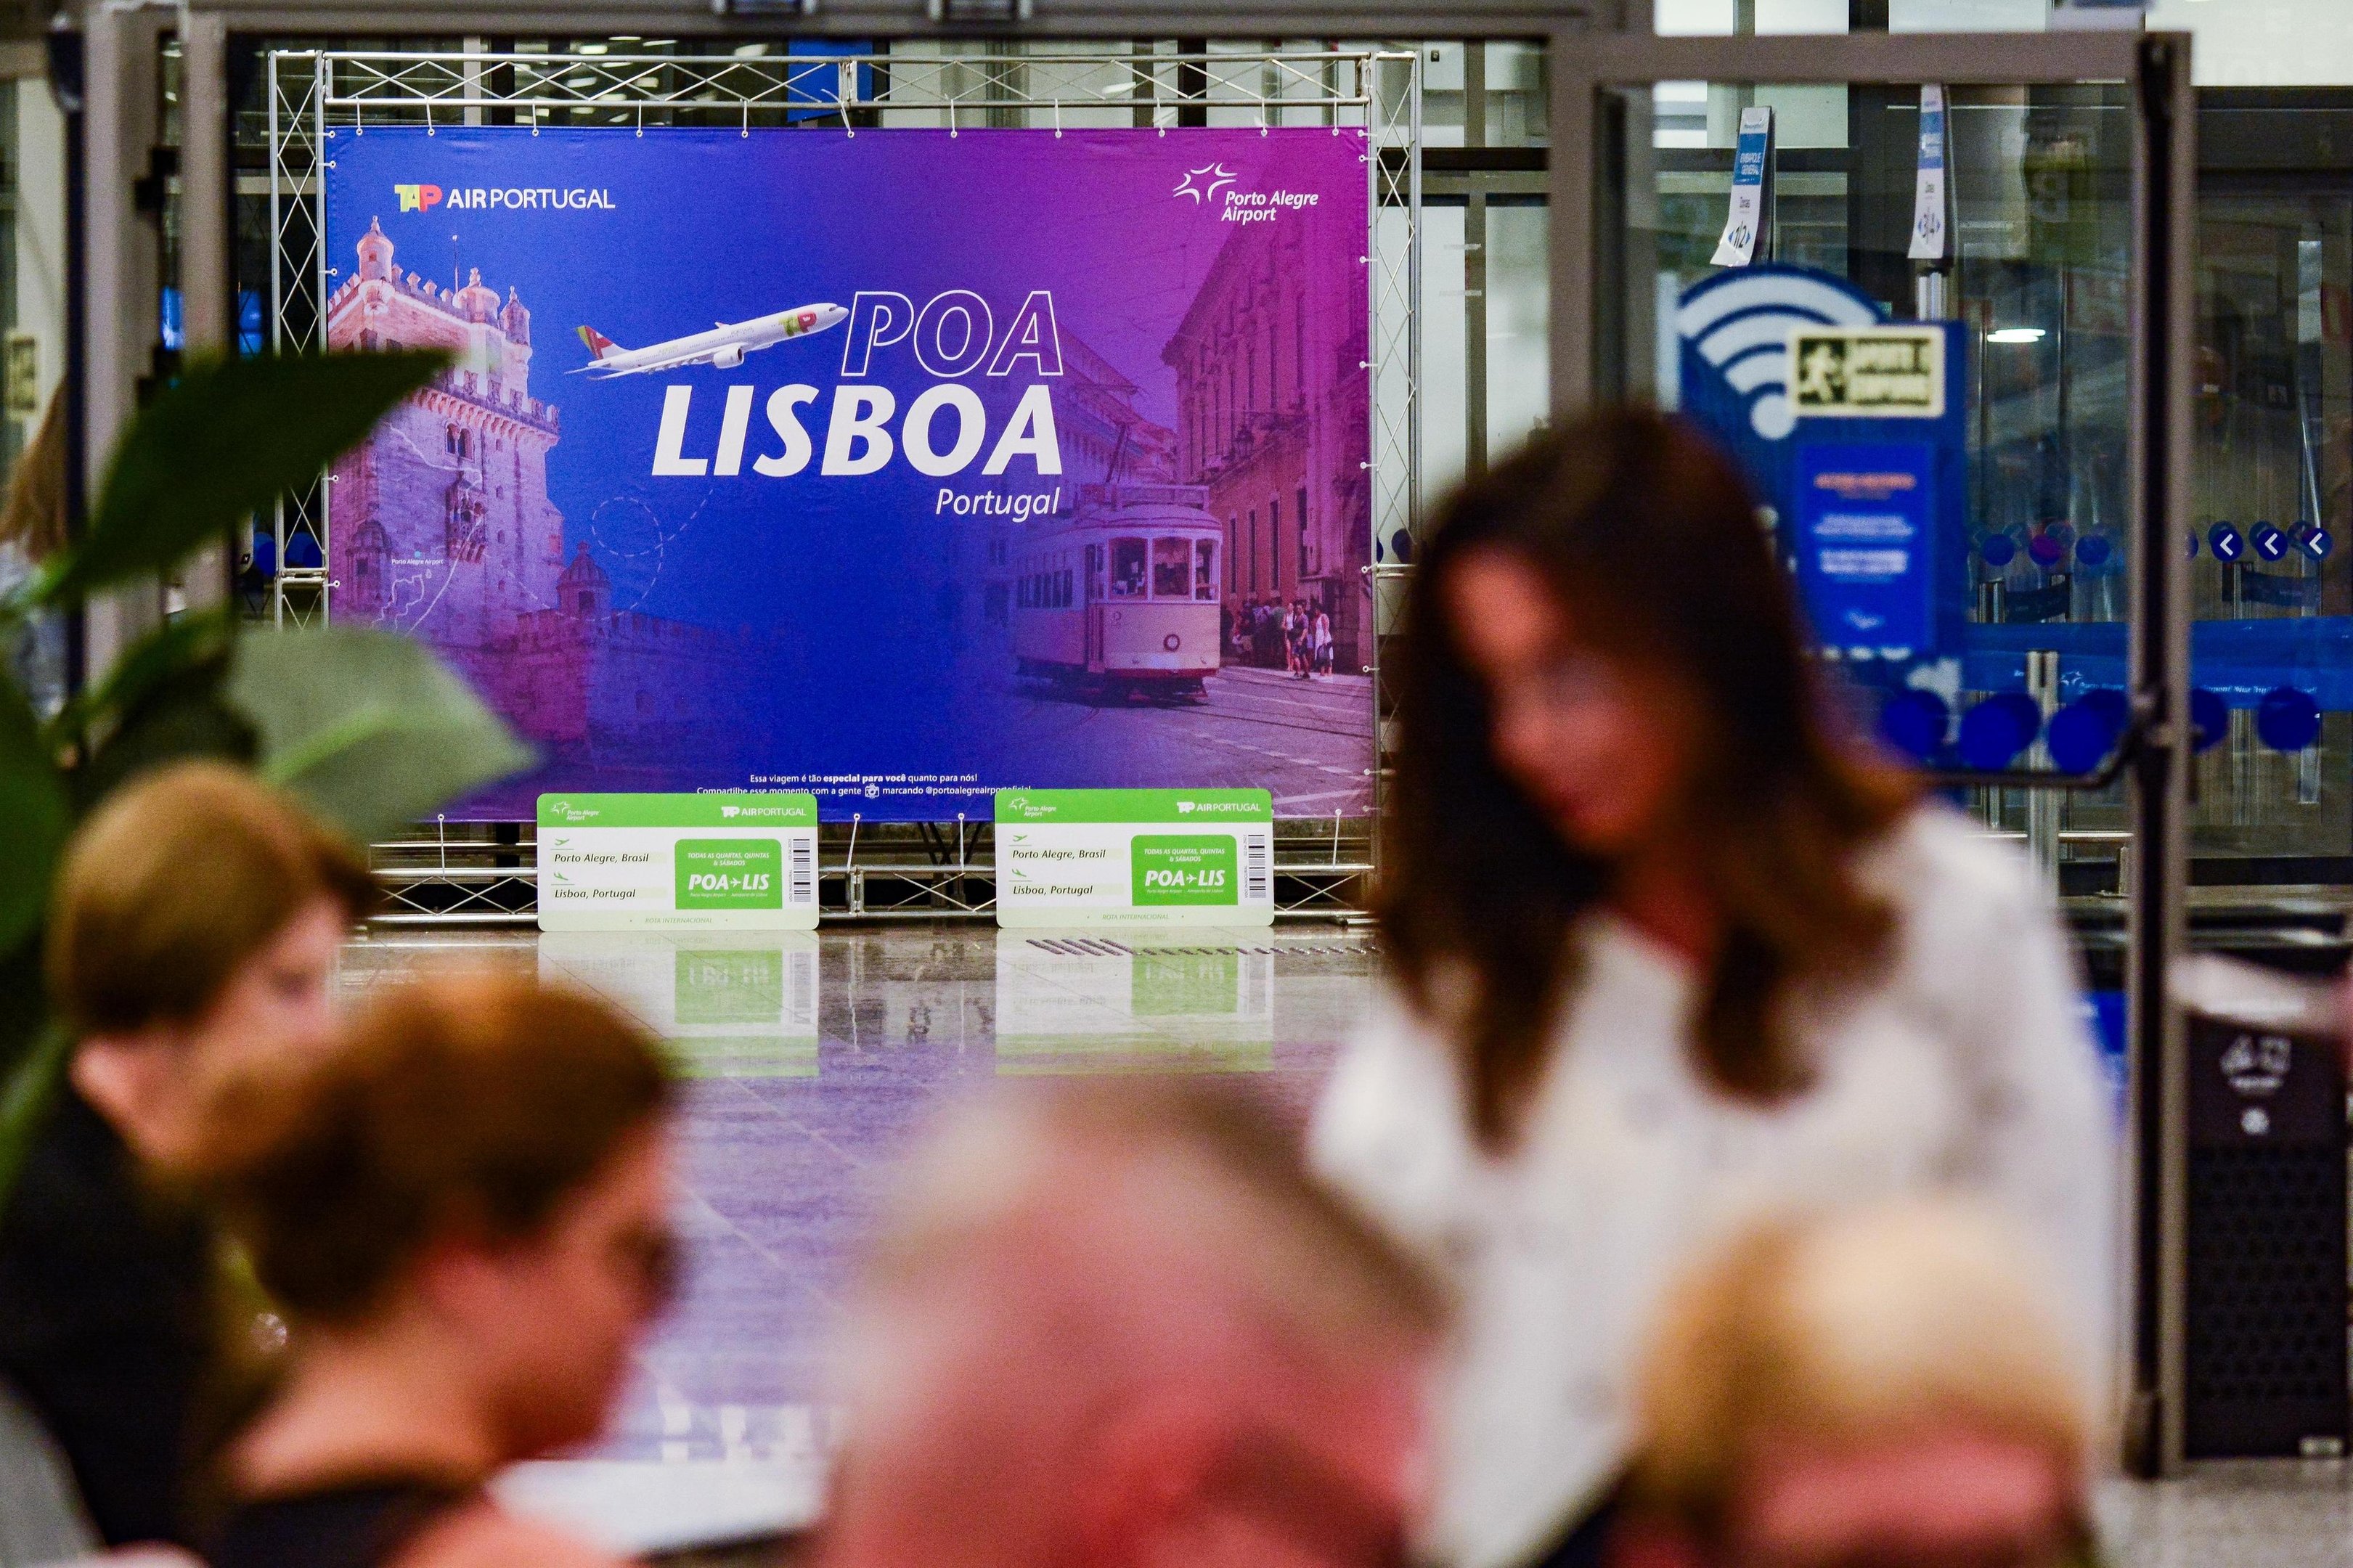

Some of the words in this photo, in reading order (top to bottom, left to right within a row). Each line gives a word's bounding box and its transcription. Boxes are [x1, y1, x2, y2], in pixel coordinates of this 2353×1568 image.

[394, 184, 443, 213] TAP
[1225, 191, 1266, 205] Porto
[1270, 190, 1318, 210] Alegre
[1221, 206, 1276, 226] Airport
[841, 289, 1064, 377] POA
[651, 383, 1063, 477] LISBOA
[935, 486, 1060, 523] Portugal
[769, 775, 799, 785] viagem
[802, 774, 807, 783] é
[823, 774, 860, 785] especial
[862, 775, 884, 784] para
[885, 774, 906, 783] você
[908, 775, 938, 784] quanto
[939, 775, 958, 784] para
[961, 774, 978, 783] nós!
[838, 788, 862, 797] gente
[883, 786, 923, 795] marcando
[555, 854, 581, 862] Porto
[584, 853, 618, 865] Alegre,
[621, 853, 649, 862] Brasil
[1012, 849, 1039, 859] Porto
[1041, 849, 1075, 861] Alegre,
[1079, 849, 1106, 859] Brasil
[688, 874, 730, 891] POA
[742, 874, 770, 891] LIS
[1144, 870, 1186, 887] POA
[1197, 870, 1226, 887] LIS
[555, 889, 589, 899] Lisboa,
[592, 889, 636, 900] Portugal
[1013, 886, 1047, 896] Lisboa,
[1051, 885, 1093, 897] Portugal
